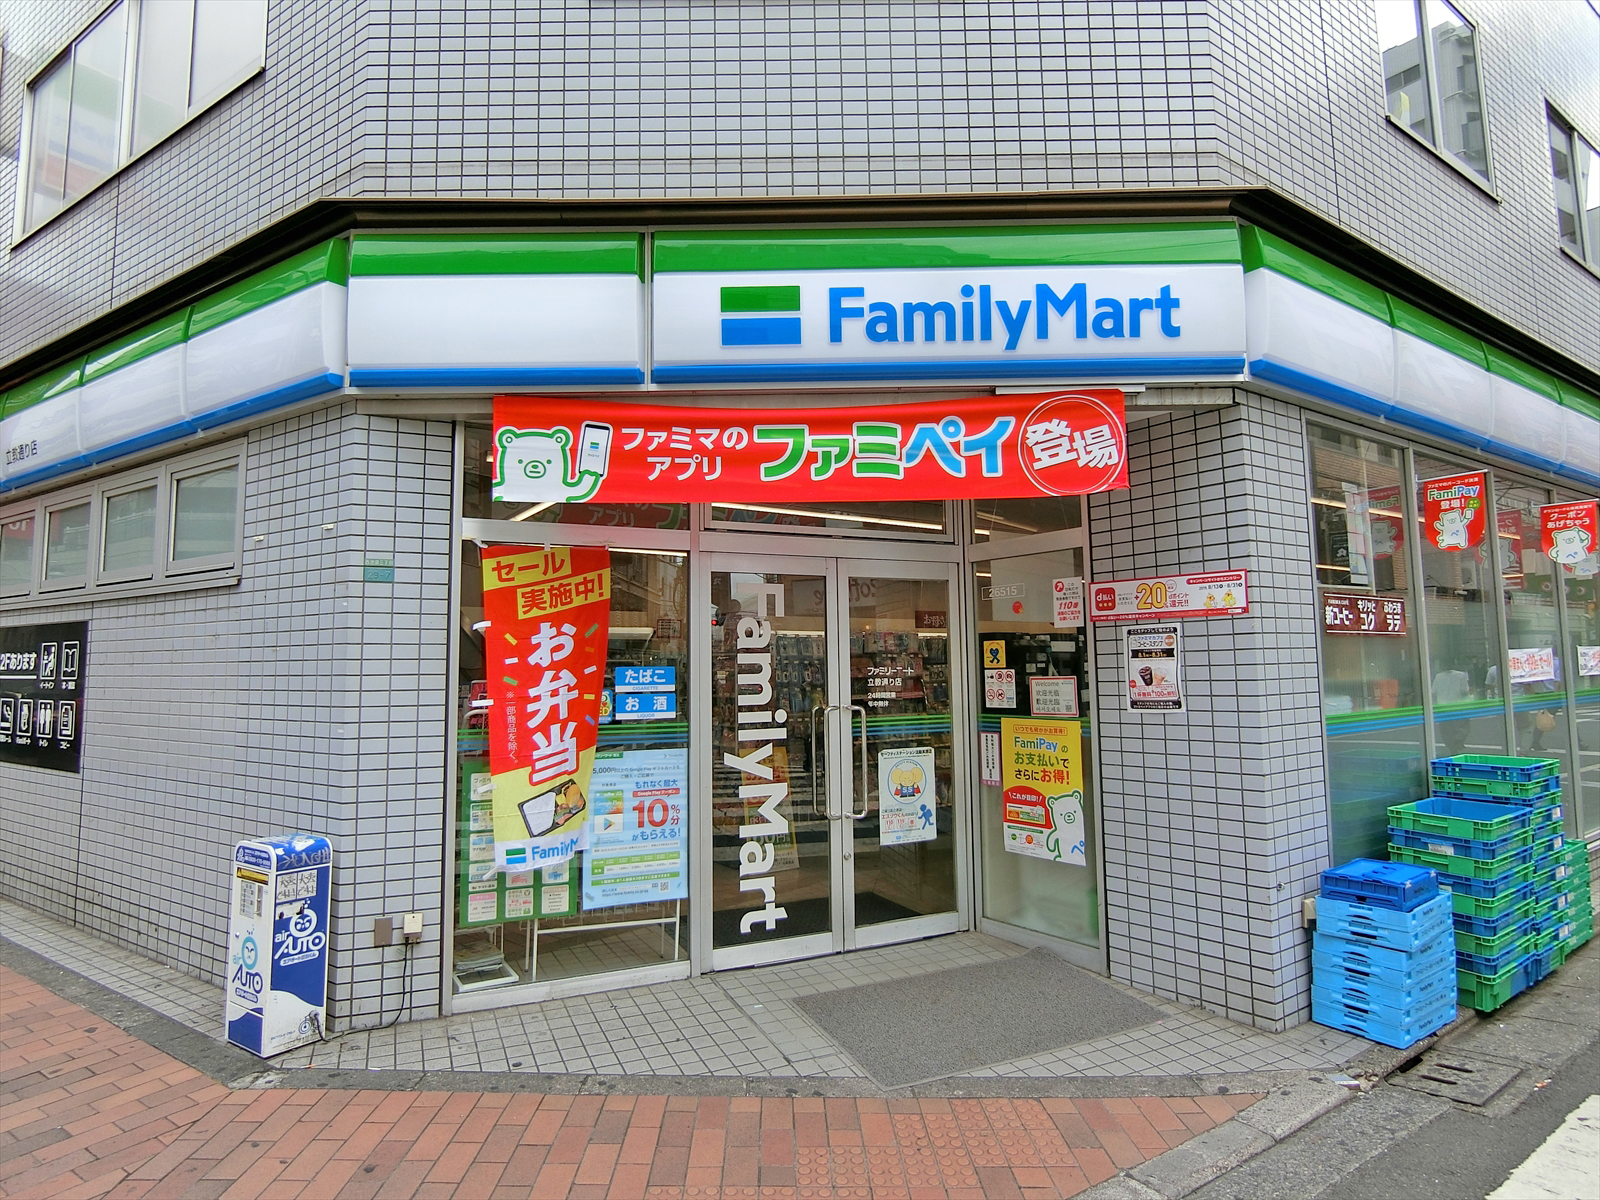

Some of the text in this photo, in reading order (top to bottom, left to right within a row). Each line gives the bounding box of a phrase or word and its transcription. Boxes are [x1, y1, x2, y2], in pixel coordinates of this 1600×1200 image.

[828, 282, 1181, 351] FamilyMart
[621, 425, 748, 453] ファミマの
[1024, 418, 1119, 471] 登場
[752, 415, 1016, 483] ファミペイ
[646, 456, 722, 480] アプリ
[1428, 486, 1479, 501] FamiPay
[1546, 517, 1590, 529] あげちゃう
[1549, 510, 1586, 521] クーポン
[491, 551, 566, 583] セール
[520, 572, 605, 616] 実施中!
[988, 585, 1017, 598] 26515
[1325, 605, 1354, 626] 新コーヒー
[1357, 599, 1376, 613] キリッと
[1360, 612, 1375, 631] コク
[1386, 614, 1401, 632] ラテ
[624, 669, 666, 684] たばこ
[527, 622, 580, 785] お弁当
[506, 691, 519, 764] ※一部商品を除く。
[1014, 736, 1069, 754] FamiPay の
[724, 583, 788, 934] FamilyMart
[1014, 751, 1070, 770] お支払いで
[635, 779, 679, 789] もれなく最大
[1014, 768, 1070, 786] さらにお得!
[632, 798, 669, 829] 10
[670, 815, 680, 826] 分
[631, 827, 681, 841] がもらえる!
[274, 932, 326, 960] AUTO
[275, 930, 290, 943] air
[231, 963, 263, 994] AUTO
